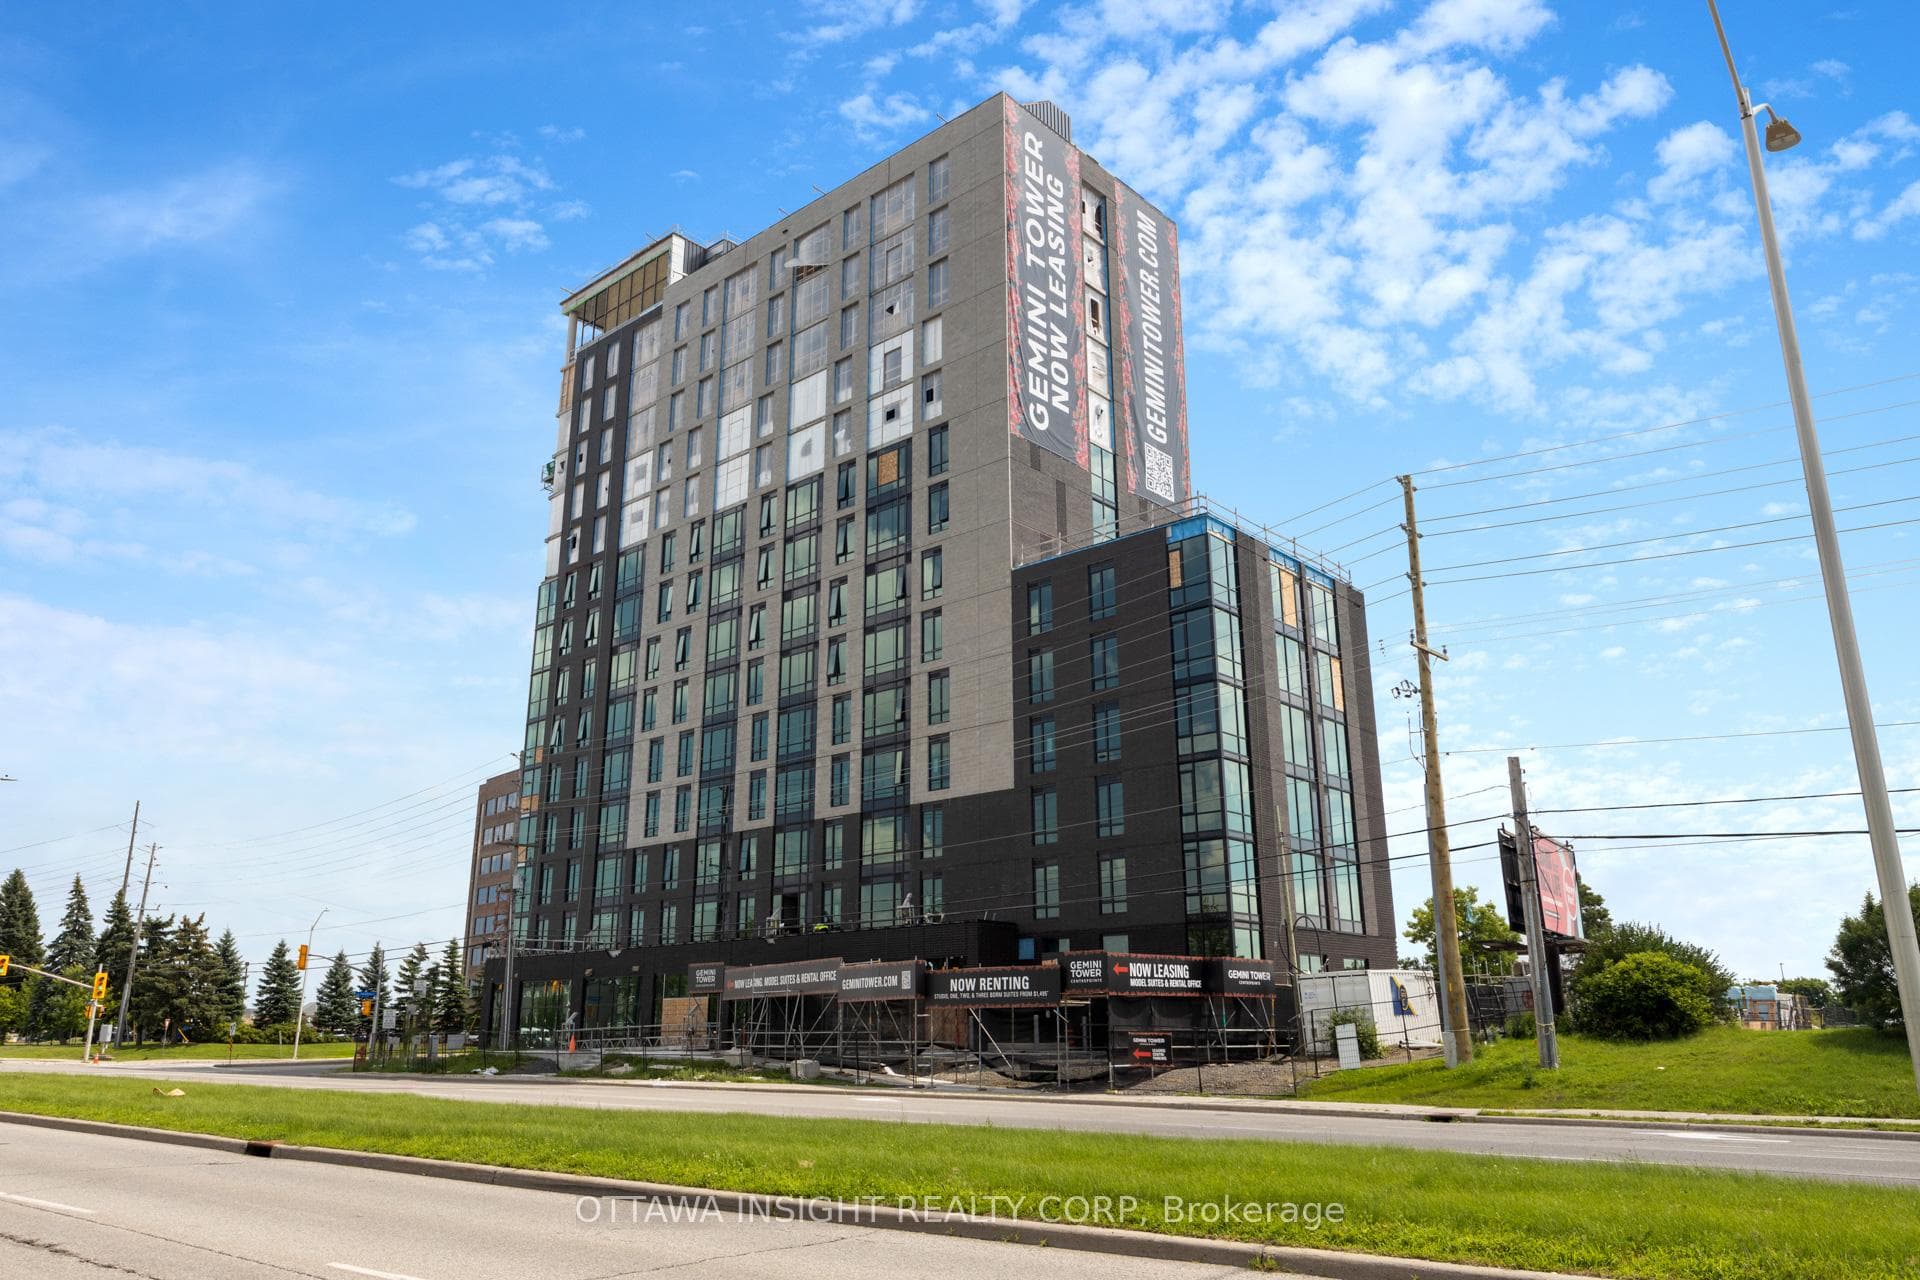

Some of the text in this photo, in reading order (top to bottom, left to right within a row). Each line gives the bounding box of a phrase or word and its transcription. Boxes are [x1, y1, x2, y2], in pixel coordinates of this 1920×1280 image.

[1024, 131, 1050, 431] GEMINI TOWER
[1046, 174, 1070, 414] NOW LEASING
[1137, 210, 1167, 444] GEMINITOWER.COM
[1070, 960, 1102, 970] GEMINI
[1129, 962, 1190, 979] NOW LEASING
[695, 969, 717, 977] GEMINI
[695, 975, 716, 984] TOWER
[734, 979, 745, 989] NOW
[763, 976, 779, 987] MODEL
[779, 974, 796, 985] SUITES
[795, 974, 801, 984] &
[801, 972, 819, 984] RENTAL
[819, 970, 837, 981] OFFICE
[1070, 968, 1102, 978] TOWER
[1228, 969, 1271, 981] GEMINI TOWER
[841, 975, 898, 990] GEMINITOWER.COM
[950, 976, 1030, 991] NOW RENTING
[1130, 978, 1202, 988] MODEL SUITES & RENTAL OFFICE
